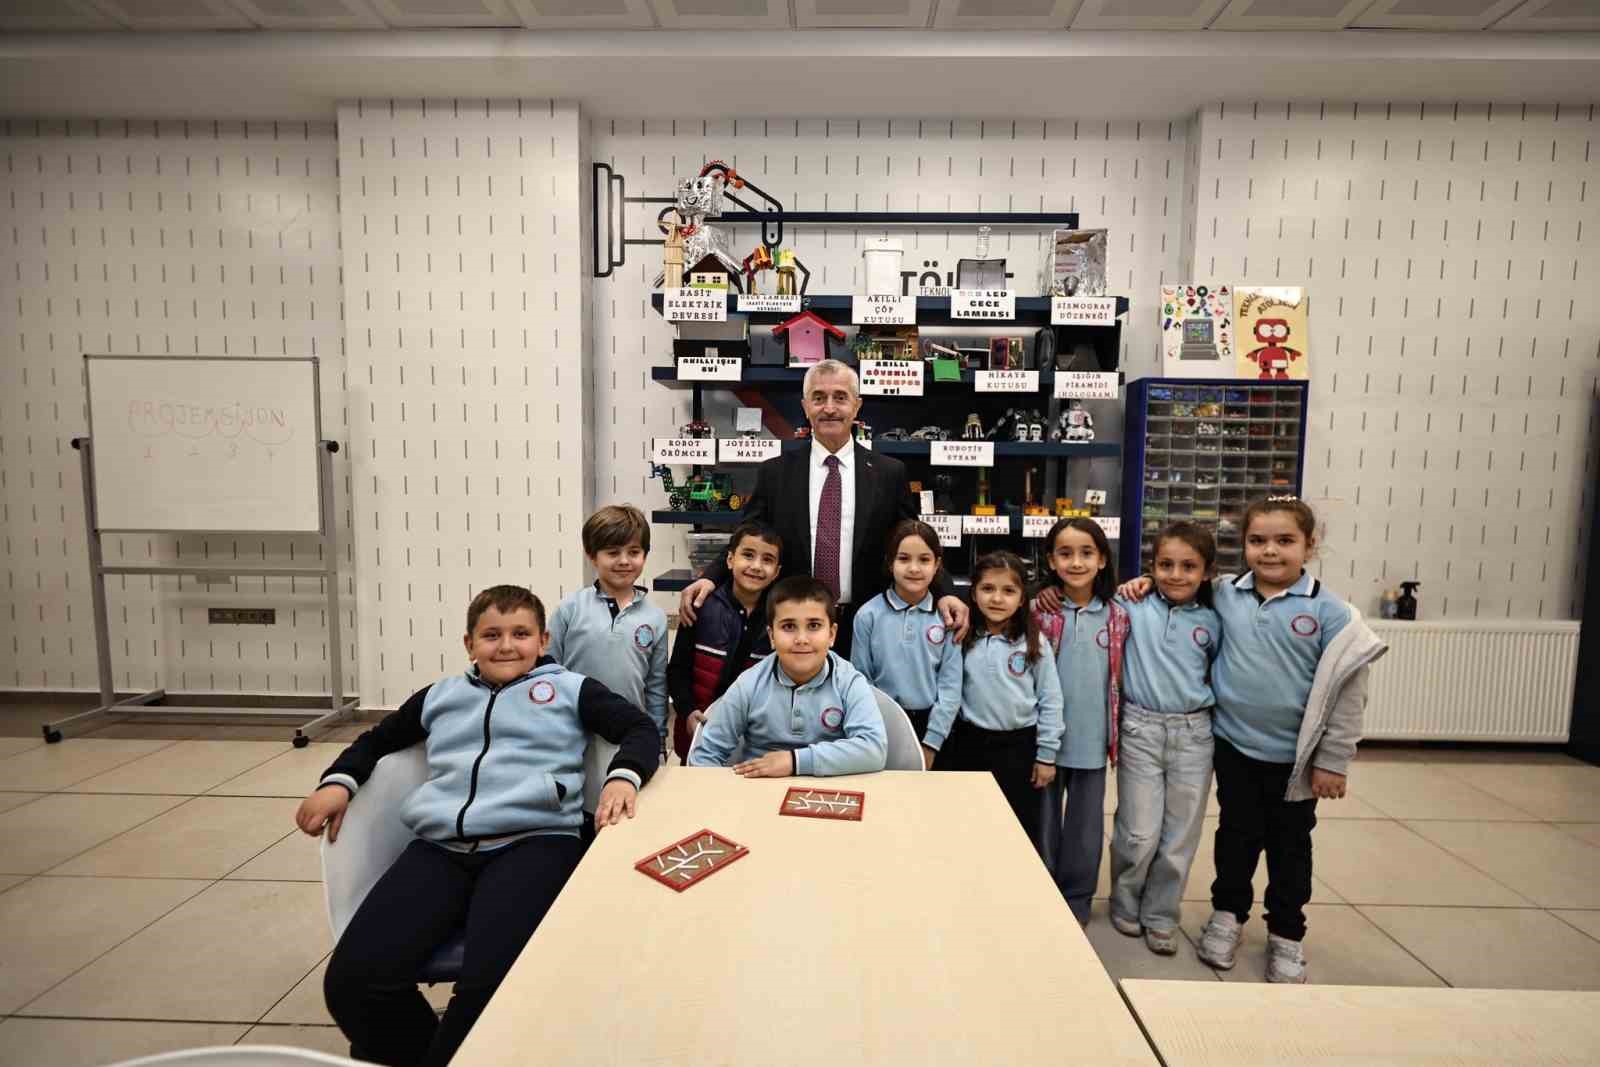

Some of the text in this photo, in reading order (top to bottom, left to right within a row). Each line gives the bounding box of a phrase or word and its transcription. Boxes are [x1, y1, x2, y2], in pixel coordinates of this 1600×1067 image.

[680, 289, 712, 297] BASİT
[668, 300, 722, 308] ELEKTRİK
[874, 305, 894, 314] ÇÖP
[672, 312, 718, 320] DEVRESİ
[957, 310, 1009, 318] LAMBASI
[660, 448, 708, 457] ÖRÜMCEK
[964, 526, 1008, 534] ASANSÖR
